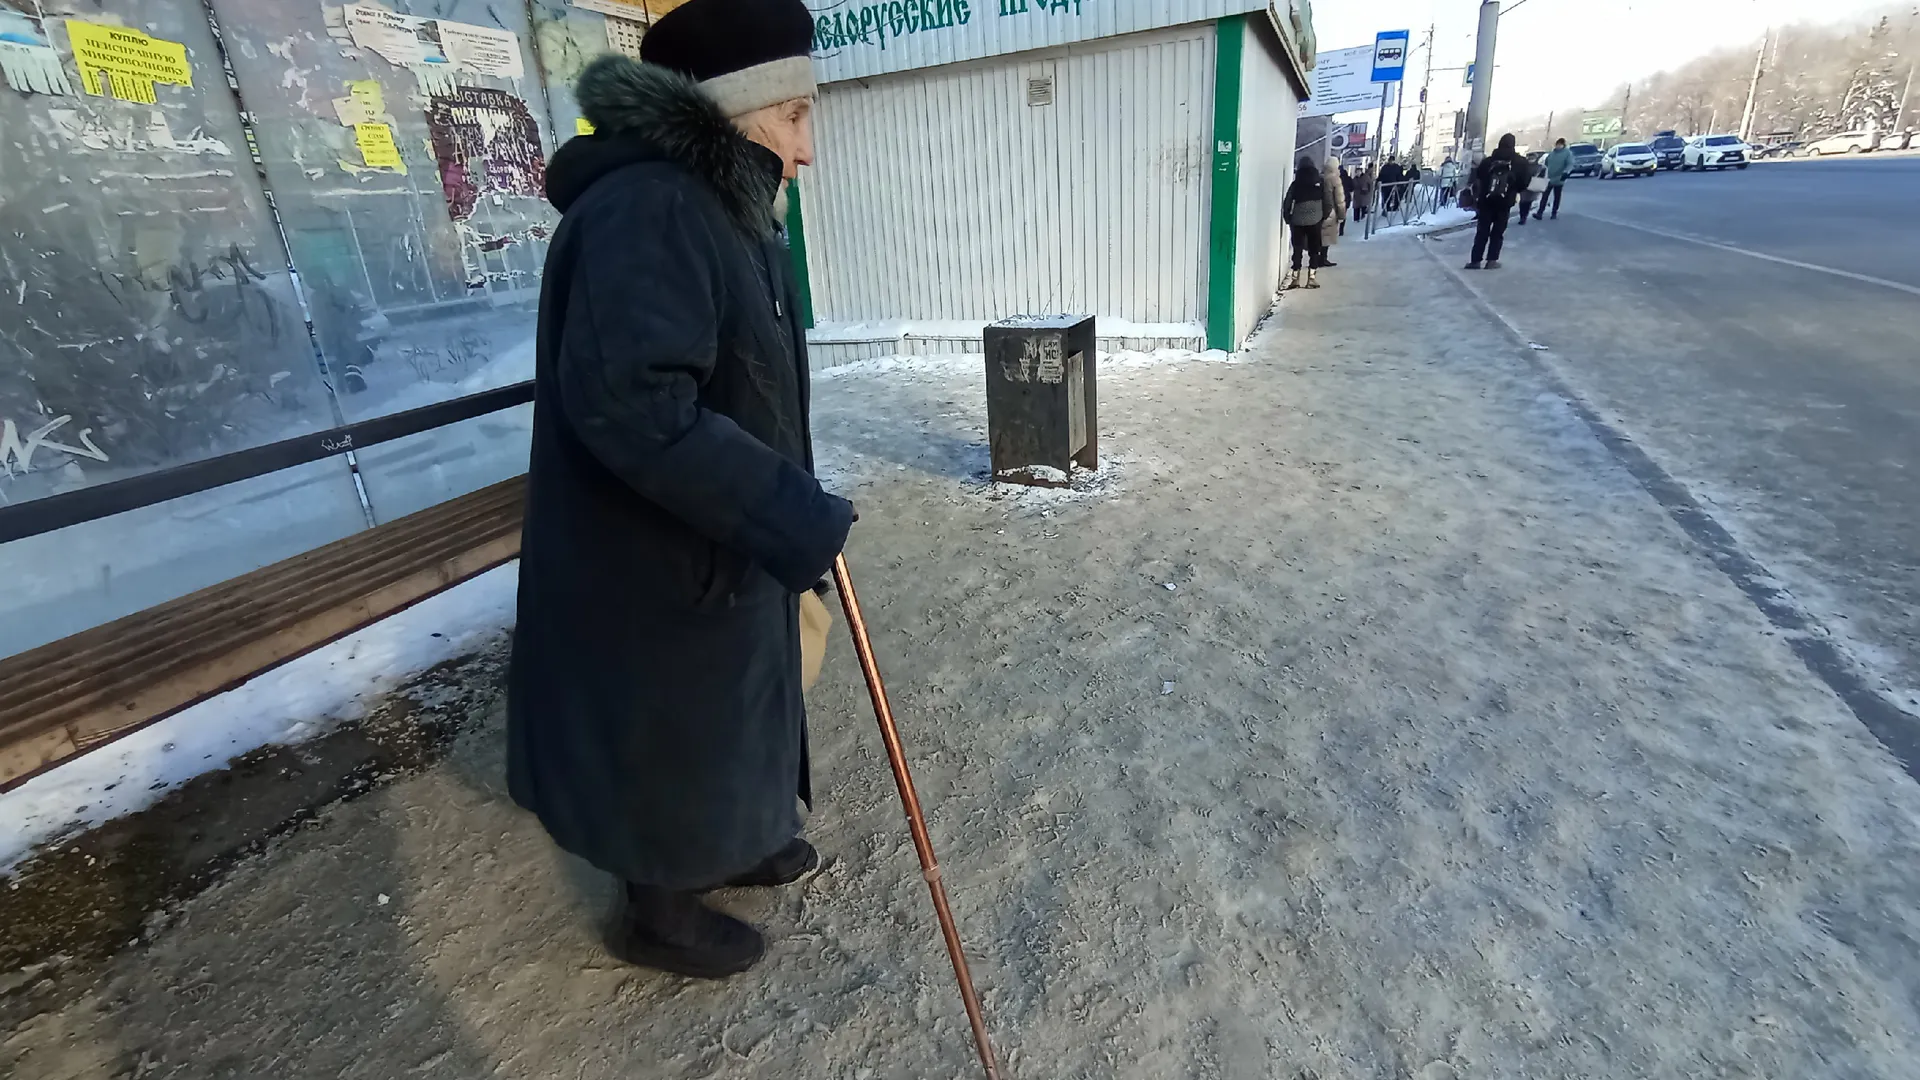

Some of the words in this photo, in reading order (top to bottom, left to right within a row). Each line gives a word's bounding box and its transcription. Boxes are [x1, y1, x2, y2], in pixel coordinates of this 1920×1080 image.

[85, 38, 176, 64] НЕИСПРАВНУЮ
[109, 31, 149, 46] КУПЛЮ
[80, 48, 184, 76] МИКРОВОЛНОВКУ
